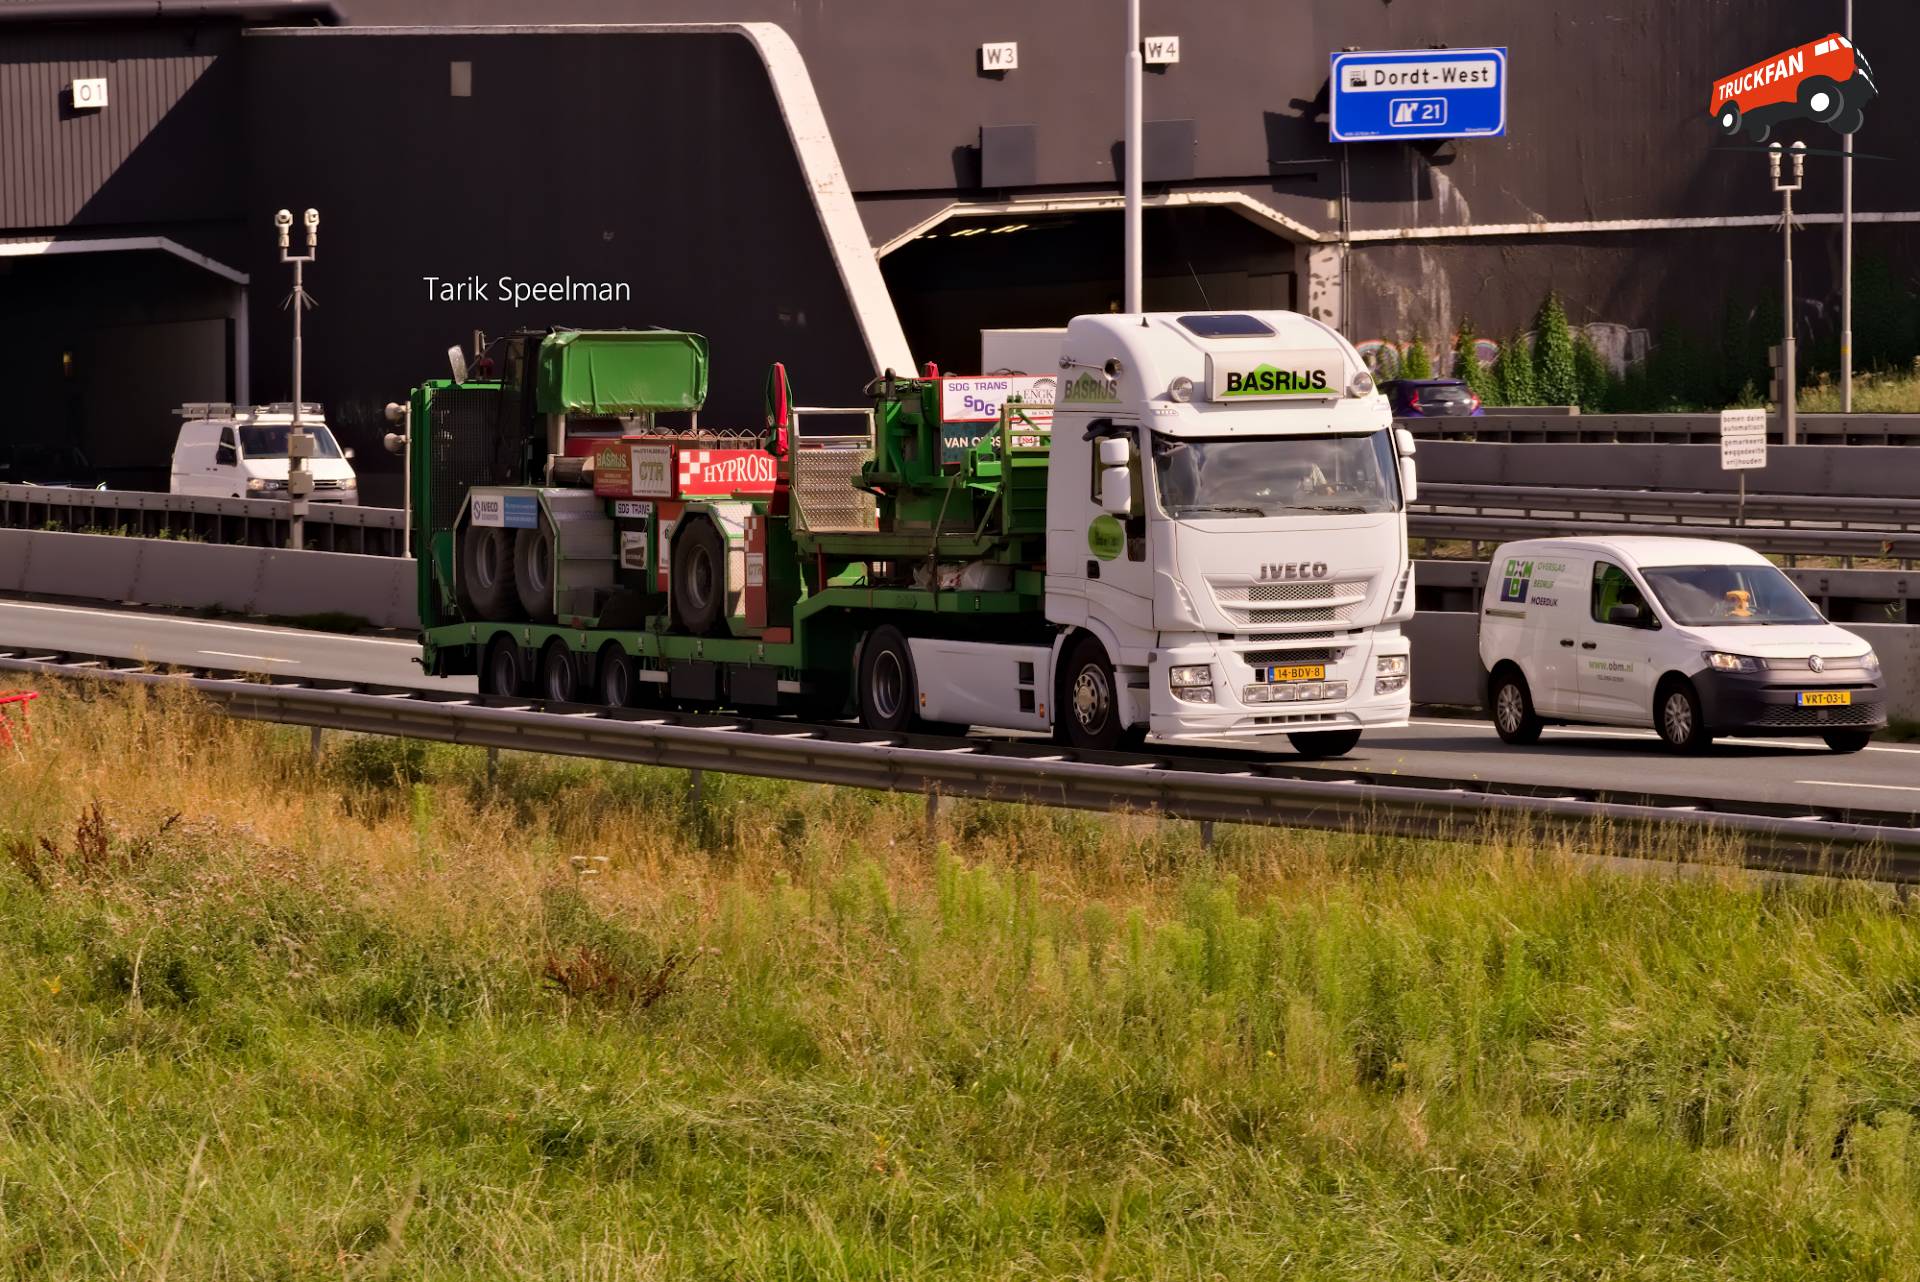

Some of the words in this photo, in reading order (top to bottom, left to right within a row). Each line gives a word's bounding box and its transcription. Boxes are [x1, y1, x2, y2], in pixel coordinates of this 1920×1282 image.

[1374, 67, 1489, 86] Dordt-West
[1421, 104, 1440, 120] 21
[948, 382, 970, 392] SDG
[975, 381, 1008, 391] TRANS
[1227, 370, 1326, 392] BASRIJS
[1064, 379, 1118, 400] BASRIJS
[964, 395, 996, 416] SDG
[944, 437, 969, 448] VAN
[481, 501, 498, 513] IVECO
[617, 503, 630, 514] SDG
[1261, 562, 1327, 579] IVECO
[1277, 667, 1321, 678] 14-BDV-8
[1805, 693, 1846, 704] VRT-03-L
